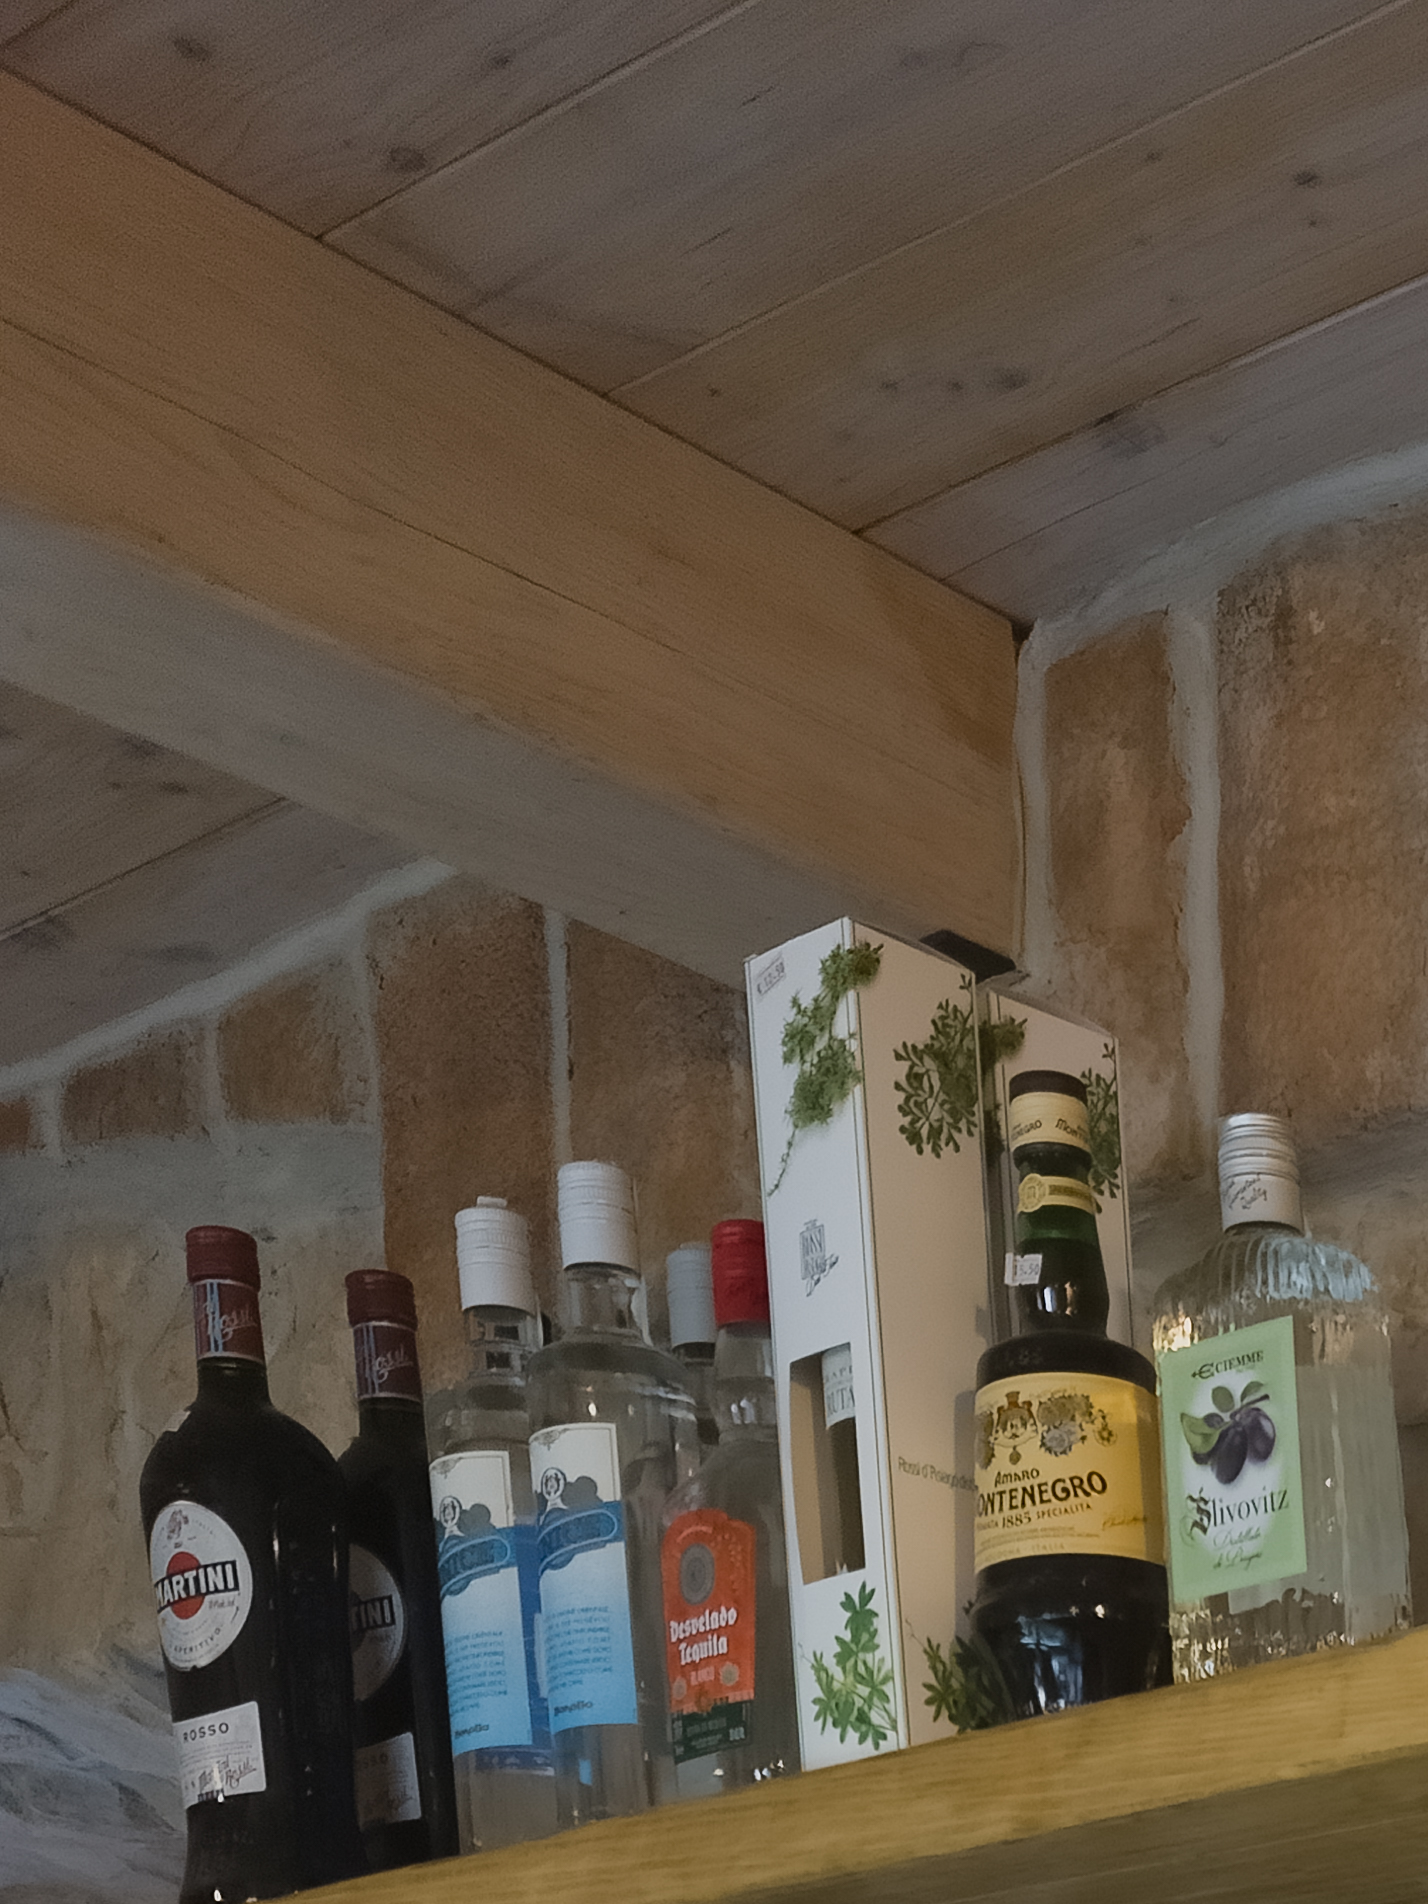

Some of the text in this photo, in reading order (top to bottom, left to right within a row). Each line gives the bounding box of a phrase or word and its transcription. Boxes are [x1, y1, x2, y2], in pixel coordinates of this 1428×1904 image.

[978, 1470, 1109, 1517] ONTENEGRO
[1001, 1511, 1033, 1530] 1885
[668, 1604, 738, 1643] Desvelado
[678, 1632, 729, 1667] Tequila
[182, 1722, 230, 1743] ROSSO
